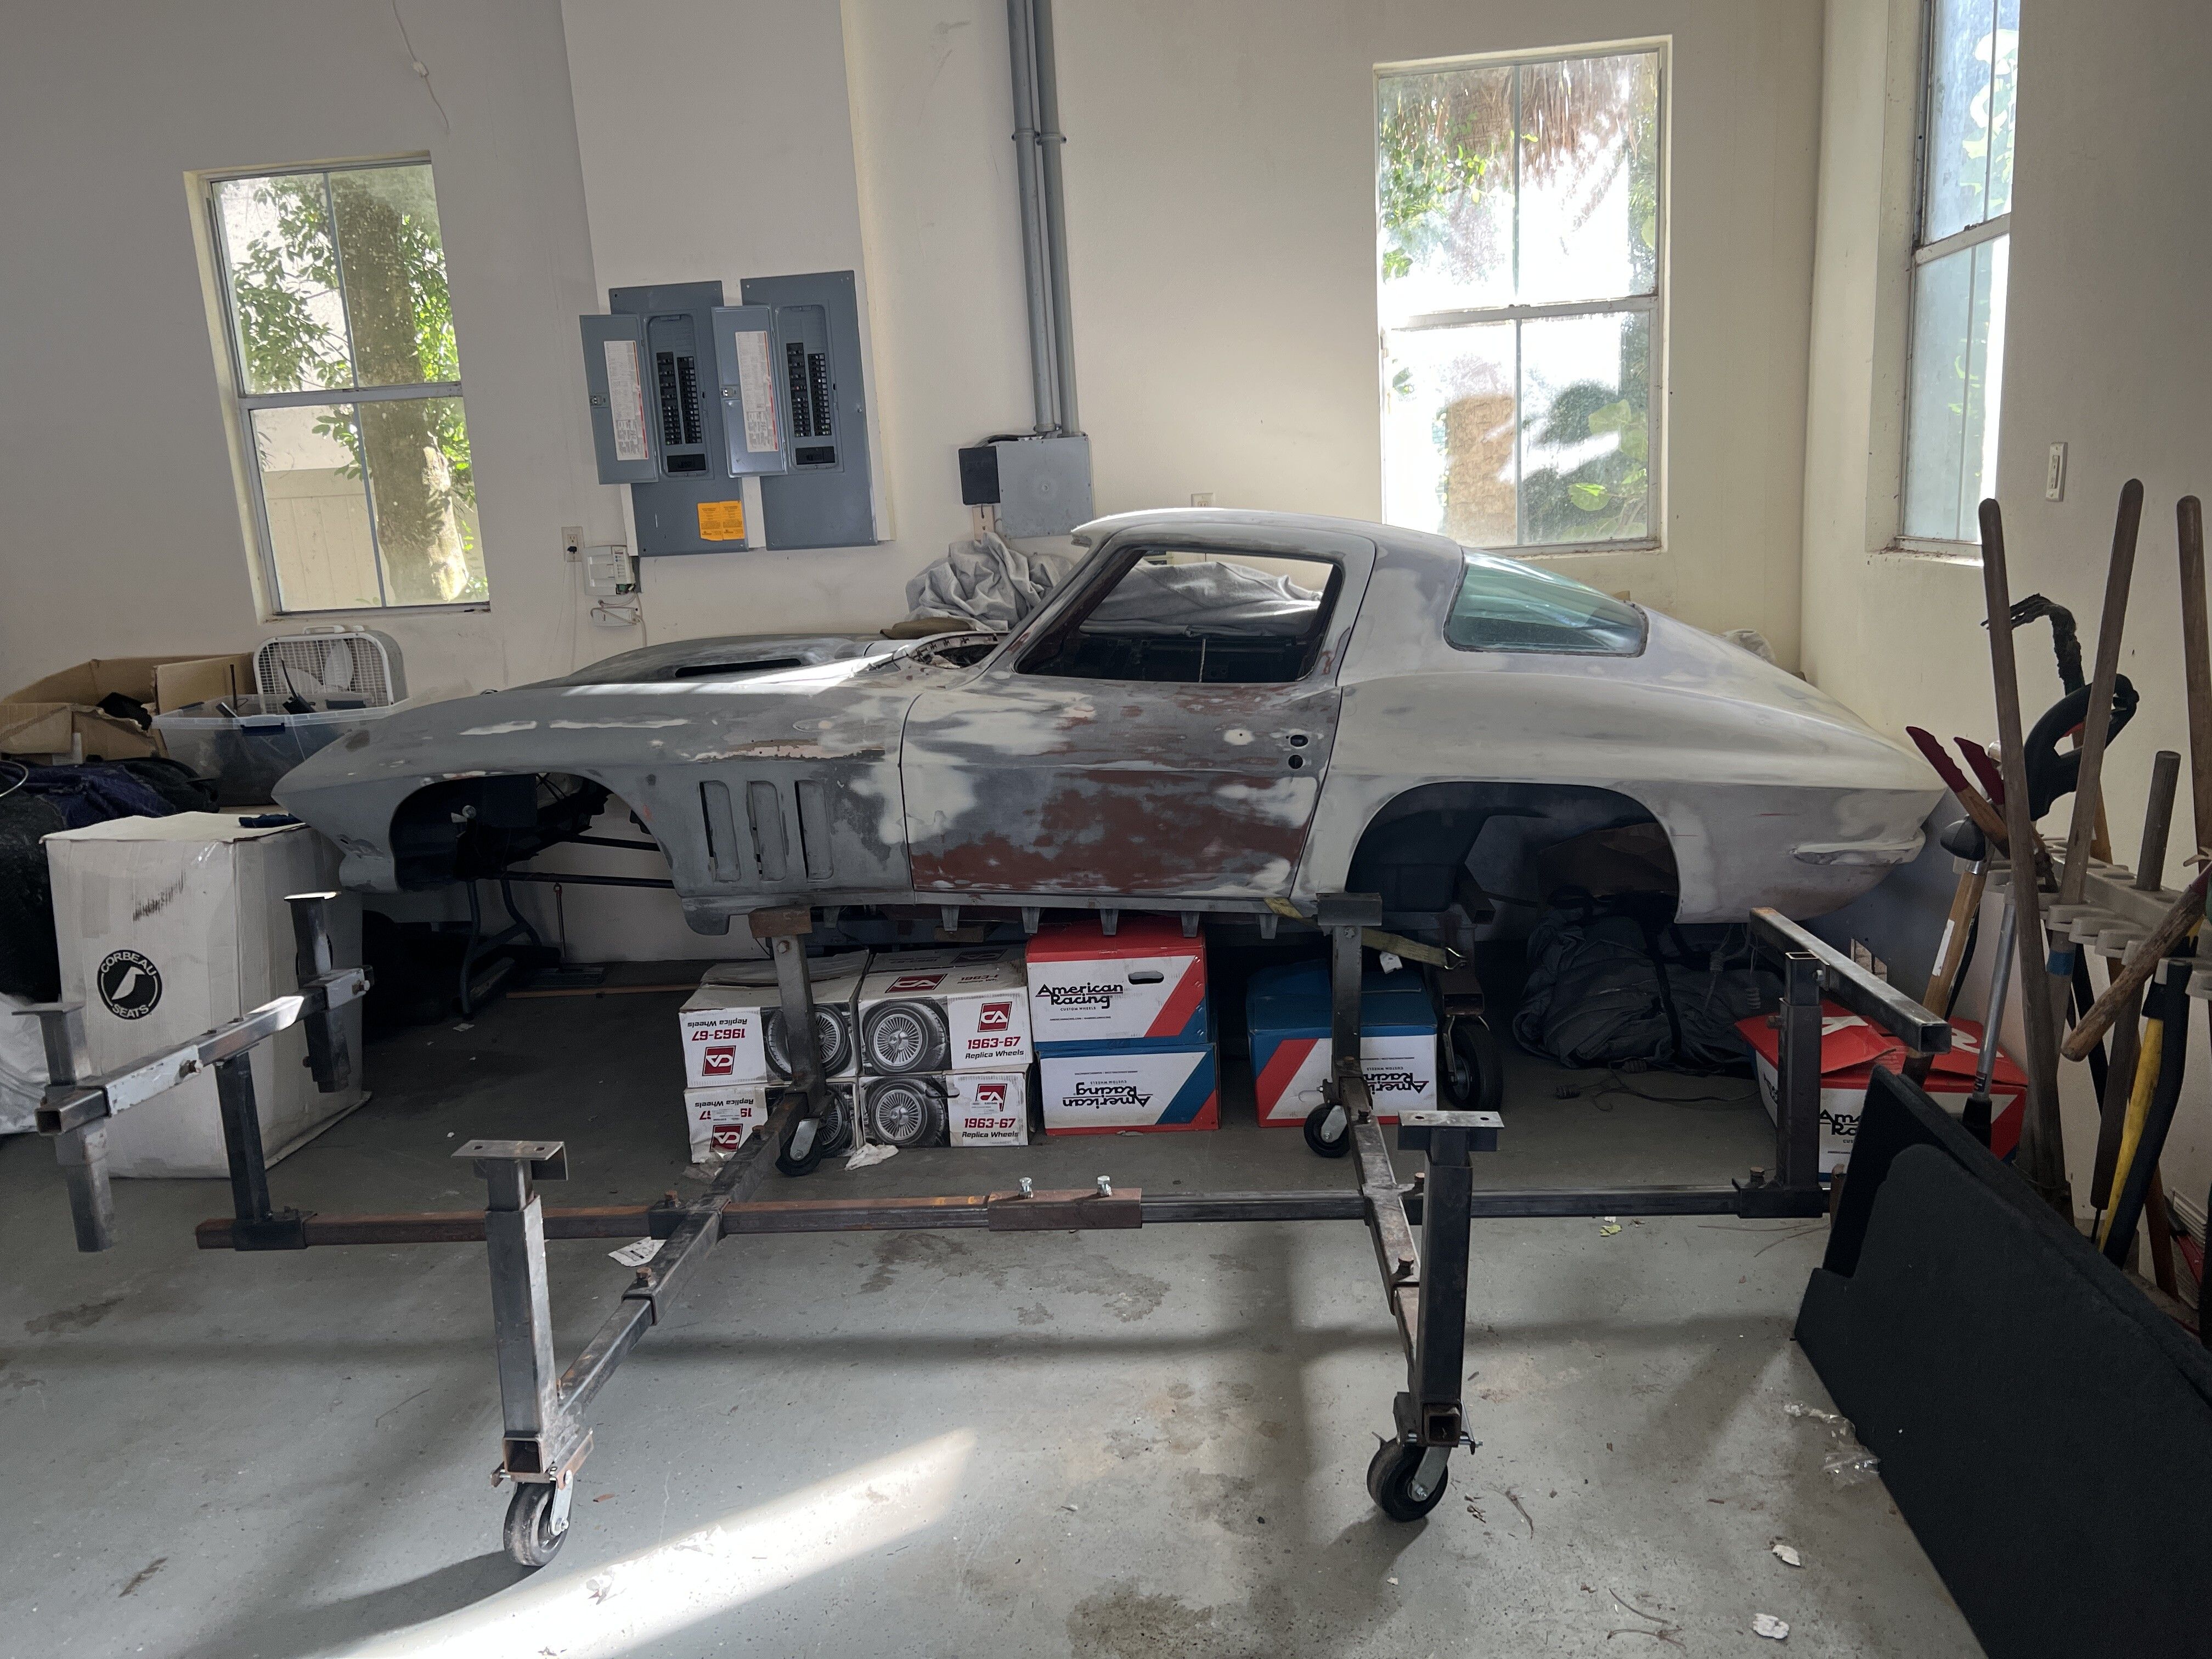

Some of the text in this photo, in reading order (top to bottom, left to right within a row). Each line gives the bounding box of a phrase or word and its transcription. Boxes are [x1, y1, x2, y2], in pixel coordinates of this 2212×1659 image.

[101, 952, 156, 975] CORBEAU
[1035, 982, 1123, 997] American
[1051, 994, 1110, 1009] Racing
[112, 1004, 149, 1018] SEATS
[981, 1010, 1008, 1024] CA
[719, 1018, 747, 1026] Replica
[692, 1028, 746, 1041] 1963-67
[968, 1036, 1021, 1049] 1963-67
[706, 1054, 733, 1068] CA
[1363, 1073, 1413, 1084] Racin
[1075, 1082, 1136, 1097] Racing
[1367, 1081, 1429, 1094] Ameri
[978, 1091, 1003, 1101] CA
[1063, 1094, 1153, 1109] American
[964, 1118, 1016, 1128] 1963-67
[713, 1131, 740, 1144] CA
